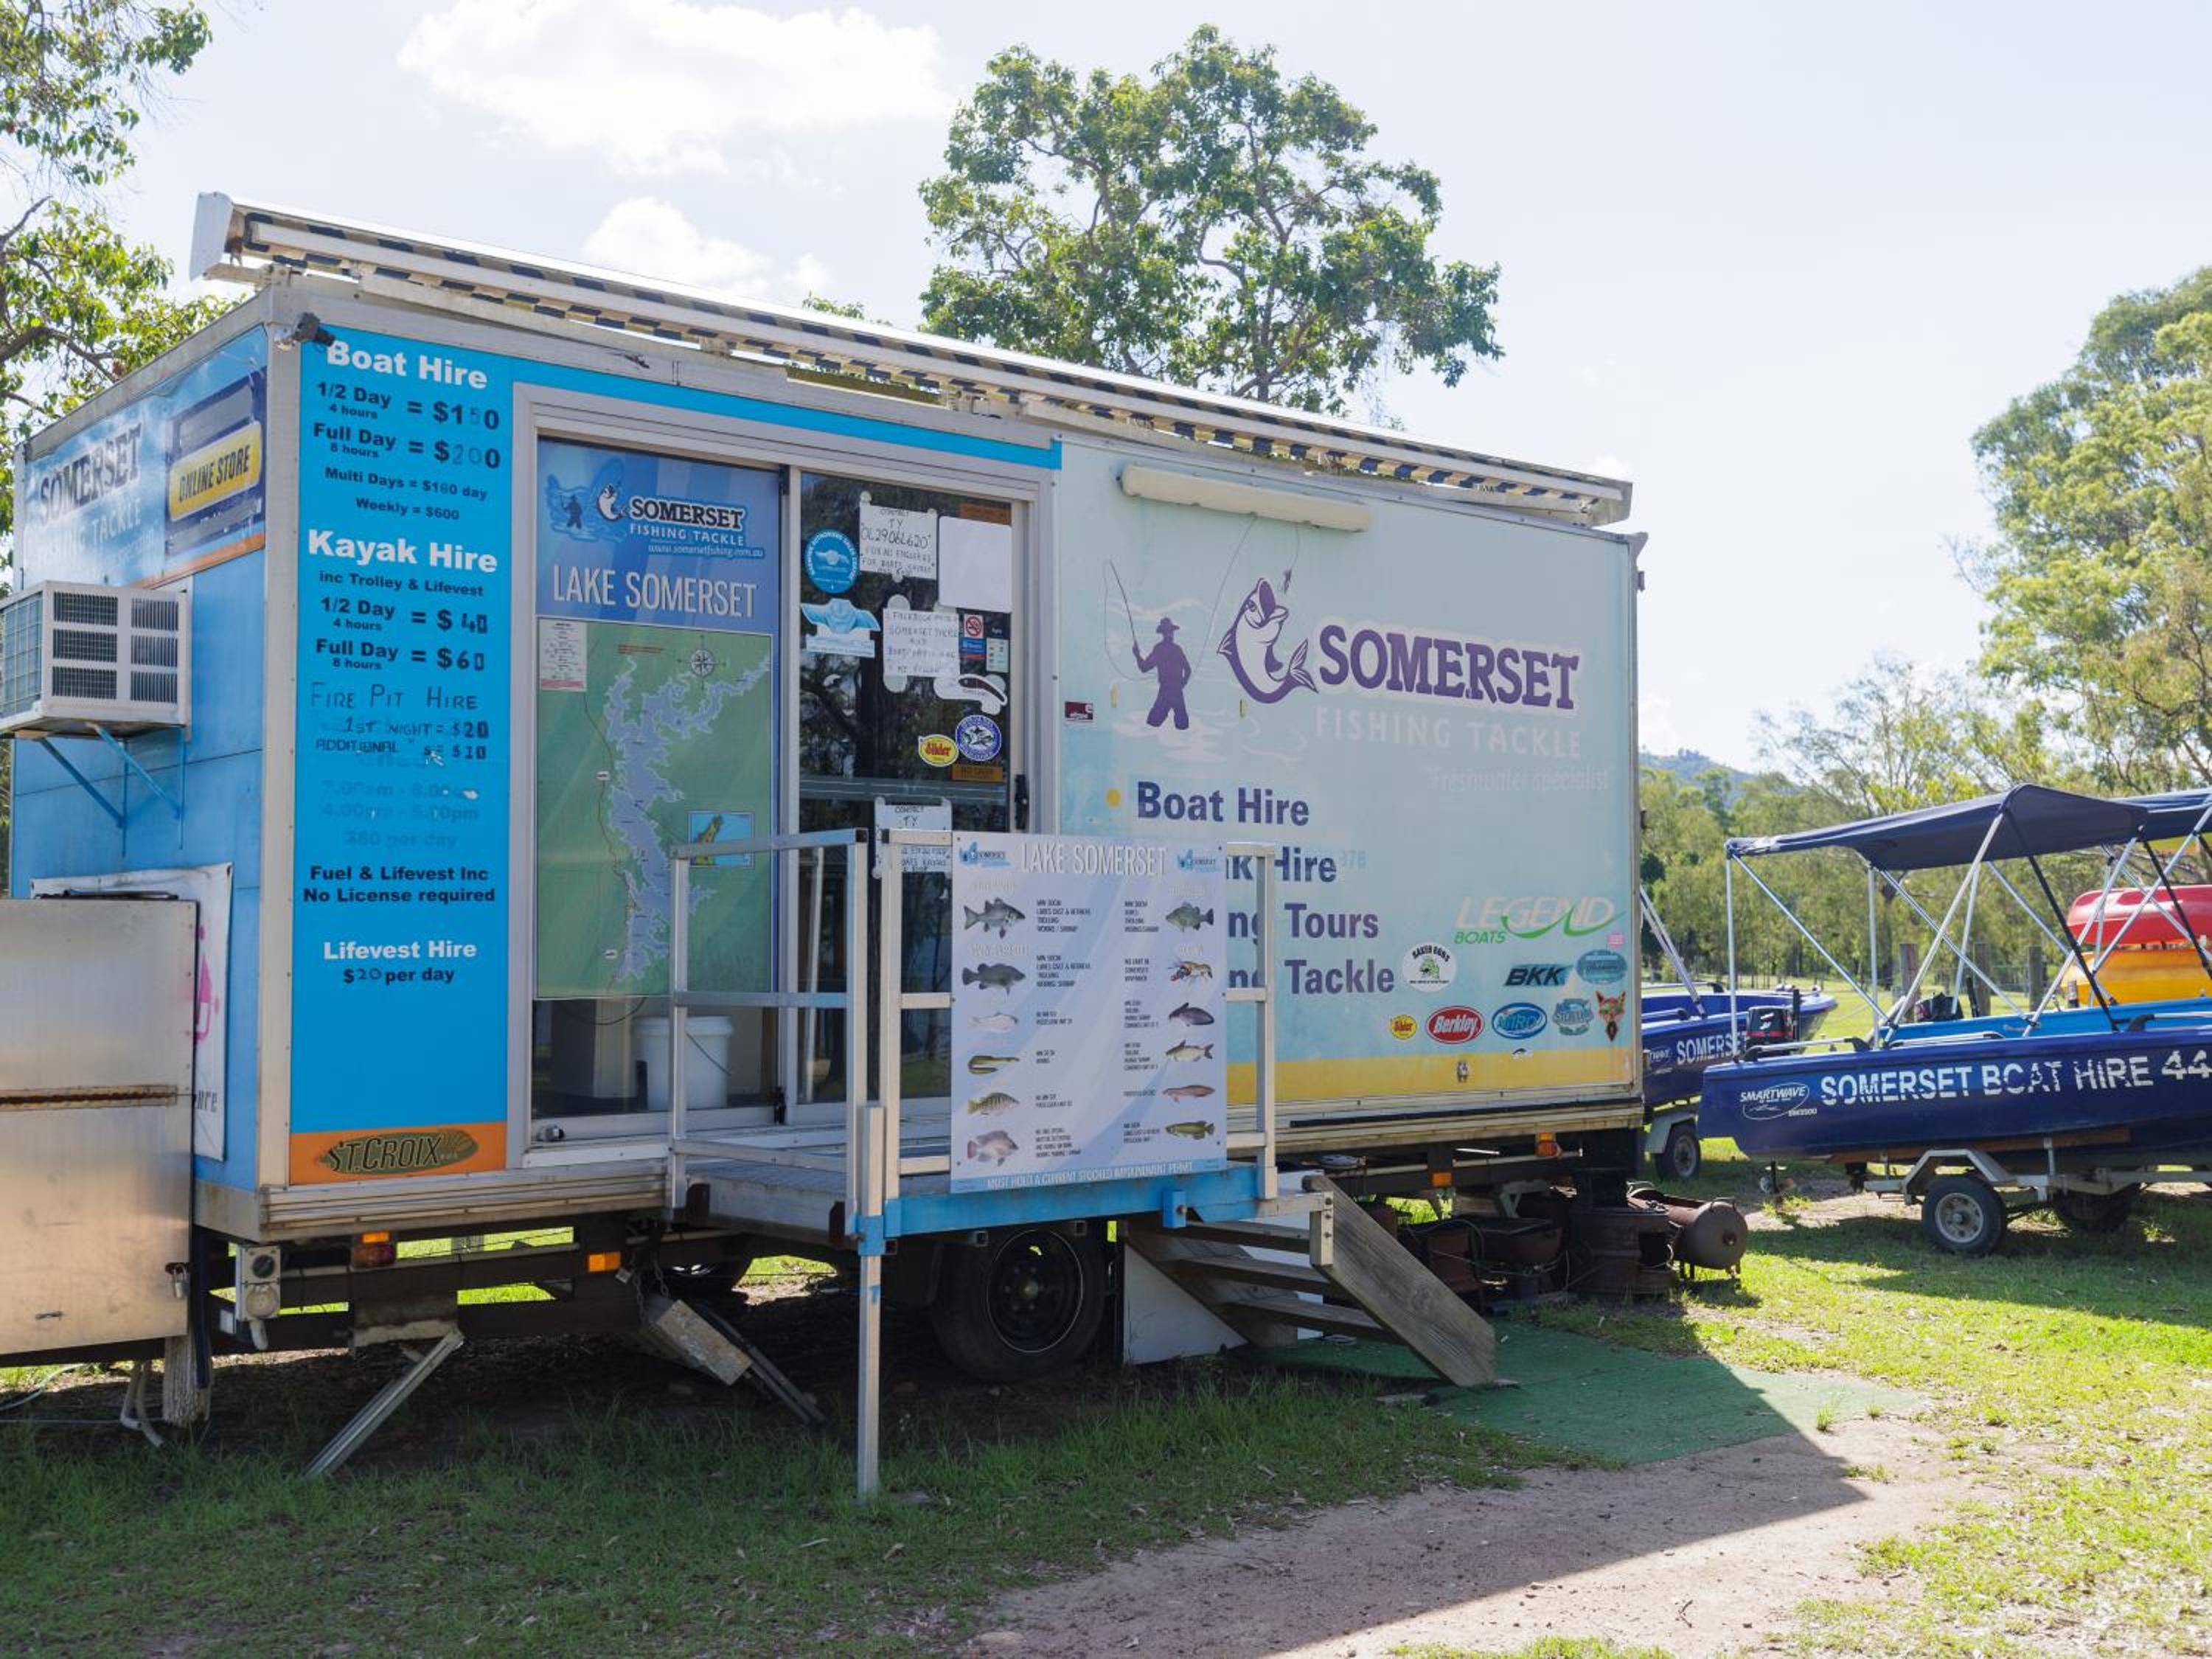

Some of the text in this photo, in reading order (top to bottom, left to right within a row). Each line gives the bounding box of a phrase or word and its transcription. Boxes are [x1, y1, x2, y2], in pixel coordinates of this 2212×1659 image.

[326, 341, 489, 390] Boat Hire
[317, 381, 347, 400] 1/2
[354, 386, 392, 409] Day
[330, 403, 378, 420] 4 hours
[313, 422, 351, 442] Full
[358, 426, 397, 451] Day
[330, 443, 379, 459] 8 hours
[178, 444, 251, 503] ONLINE STORE
[325, 466, 364, 483] Multi
[368, 472, 405, 490] Days
[462, 485, 488, 501] day
[355, 497, 408, 518] Weekly
[630, 497, 745, 531] SOMERSET
[630, 523, 745, 546] FISHING TACKLE
[308, 528, 498, 573] Kayak Hire
[319, 570, 484, 597] inc Trolley & Lifevest
[554, 563, 757, 619] LAKE SOMERSET
[320, 596, 350, 615] 1/2
[358, 599, 395, 622] Day
[333, 618, 382, 633] 4 hours
[316, 638, 352, 657] Full
[360, 641, 399, 664] Day
[333, 658, 382, 672] 8 hours
[1318, 624, 1579, 711] SOMERSET
[310, 681, 478, 710] FIRE PIT HIRE
[1315, 706, 1582, 759] FISHING TACKLE
[1138, 781, 1310, 827] Boat Hire
[1021, 843, 1168, 876] LAKE SOMERSET
[1275, 846, 1338, 883] Hire
[310, 866, 488, 882] Fuel & Lifevest Inc
[303, 888, 495, 906] No License required
[1284, 902, 1379, 939] Tours
[1455, 896, 1616, 931] LEGEND
[324, 940, 477, 960] Lifevest Hire
[1453, 931, 1507, 945] BOATS
[385, 970, 415, 985] per
[422, 967, 455, 984] day
[1284, 959, 1395, 995] Tackle
[1504, 967, 1566, 987] BKK
[1433, 1013, 1479, 1036] Berkley
[1740, 1085, 1807, 1104] SMARTWAVE
[1820, 1066, 1972, 1105] SOMERSET
[1981, 1061, 2063, 1096] BOAT
[2073, 1056, 2154, 1090] HIRE
